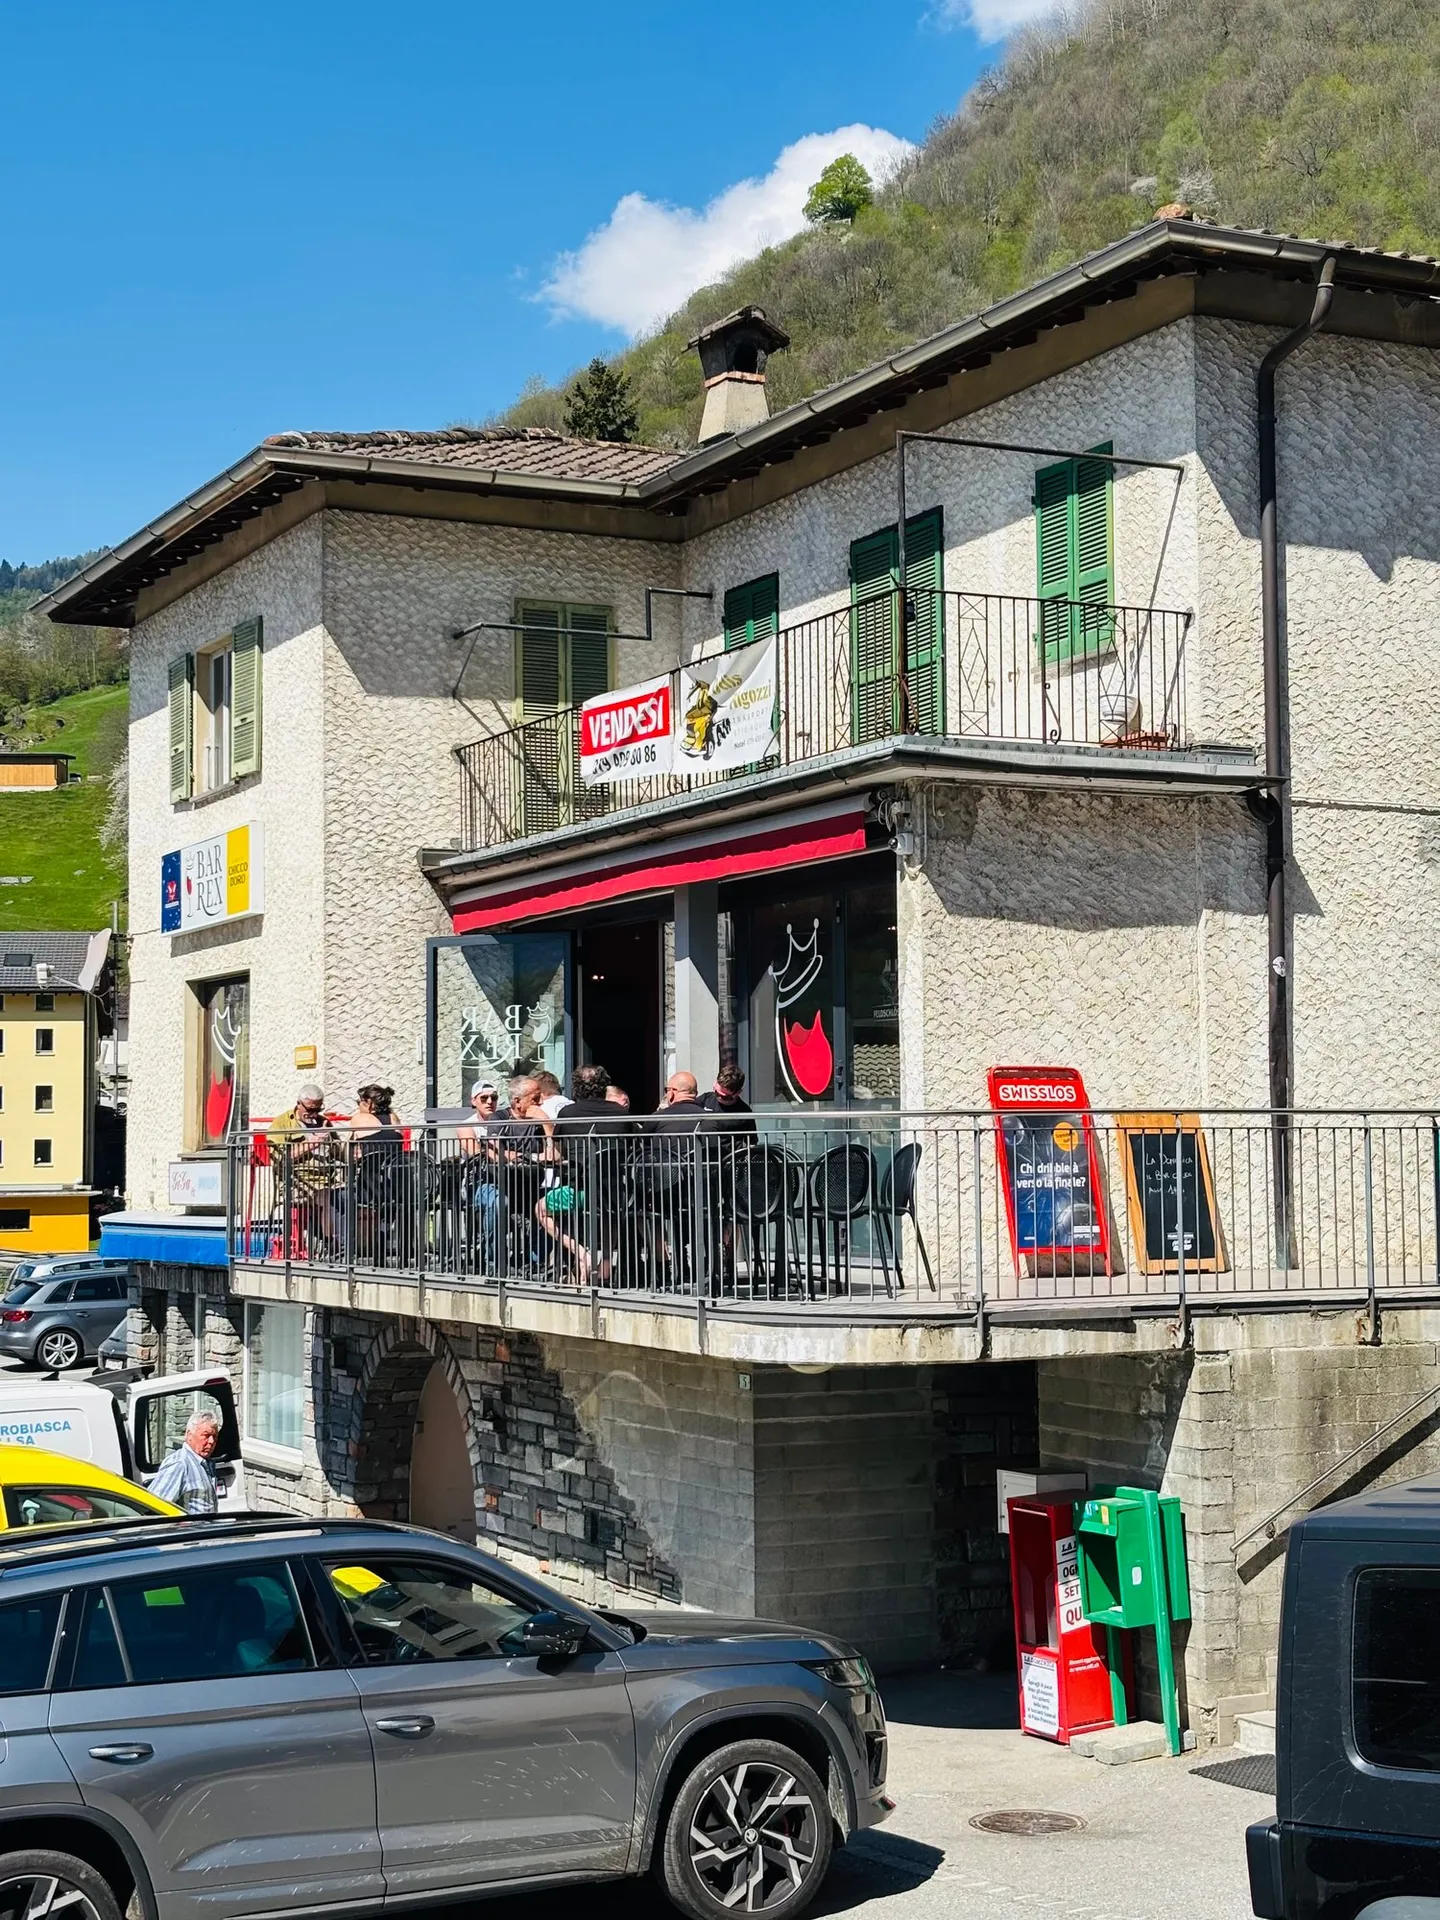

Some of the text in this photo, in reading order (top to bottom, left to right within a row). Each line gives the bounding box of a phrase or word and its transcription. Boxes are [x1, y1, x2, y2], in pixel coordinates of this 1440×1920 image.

[588, 695, 664, 748] VENDESI
[644, 744, 656, 762] 86
[196, 845, 222, 879] BAR
[196, 876, 223, 916] REX
[1001, 1085, 1075, 1100] SWISSLOS
[1020, 1163, 1035, 1174] Ch
[1017, 1177, 1086, 1189] verso la finale?
[0, 1421, 72, 1436] ROBIASCA
[1064, 1584, 1079, 1598] SET
[1066, 1606, 1082, 1625] QU
